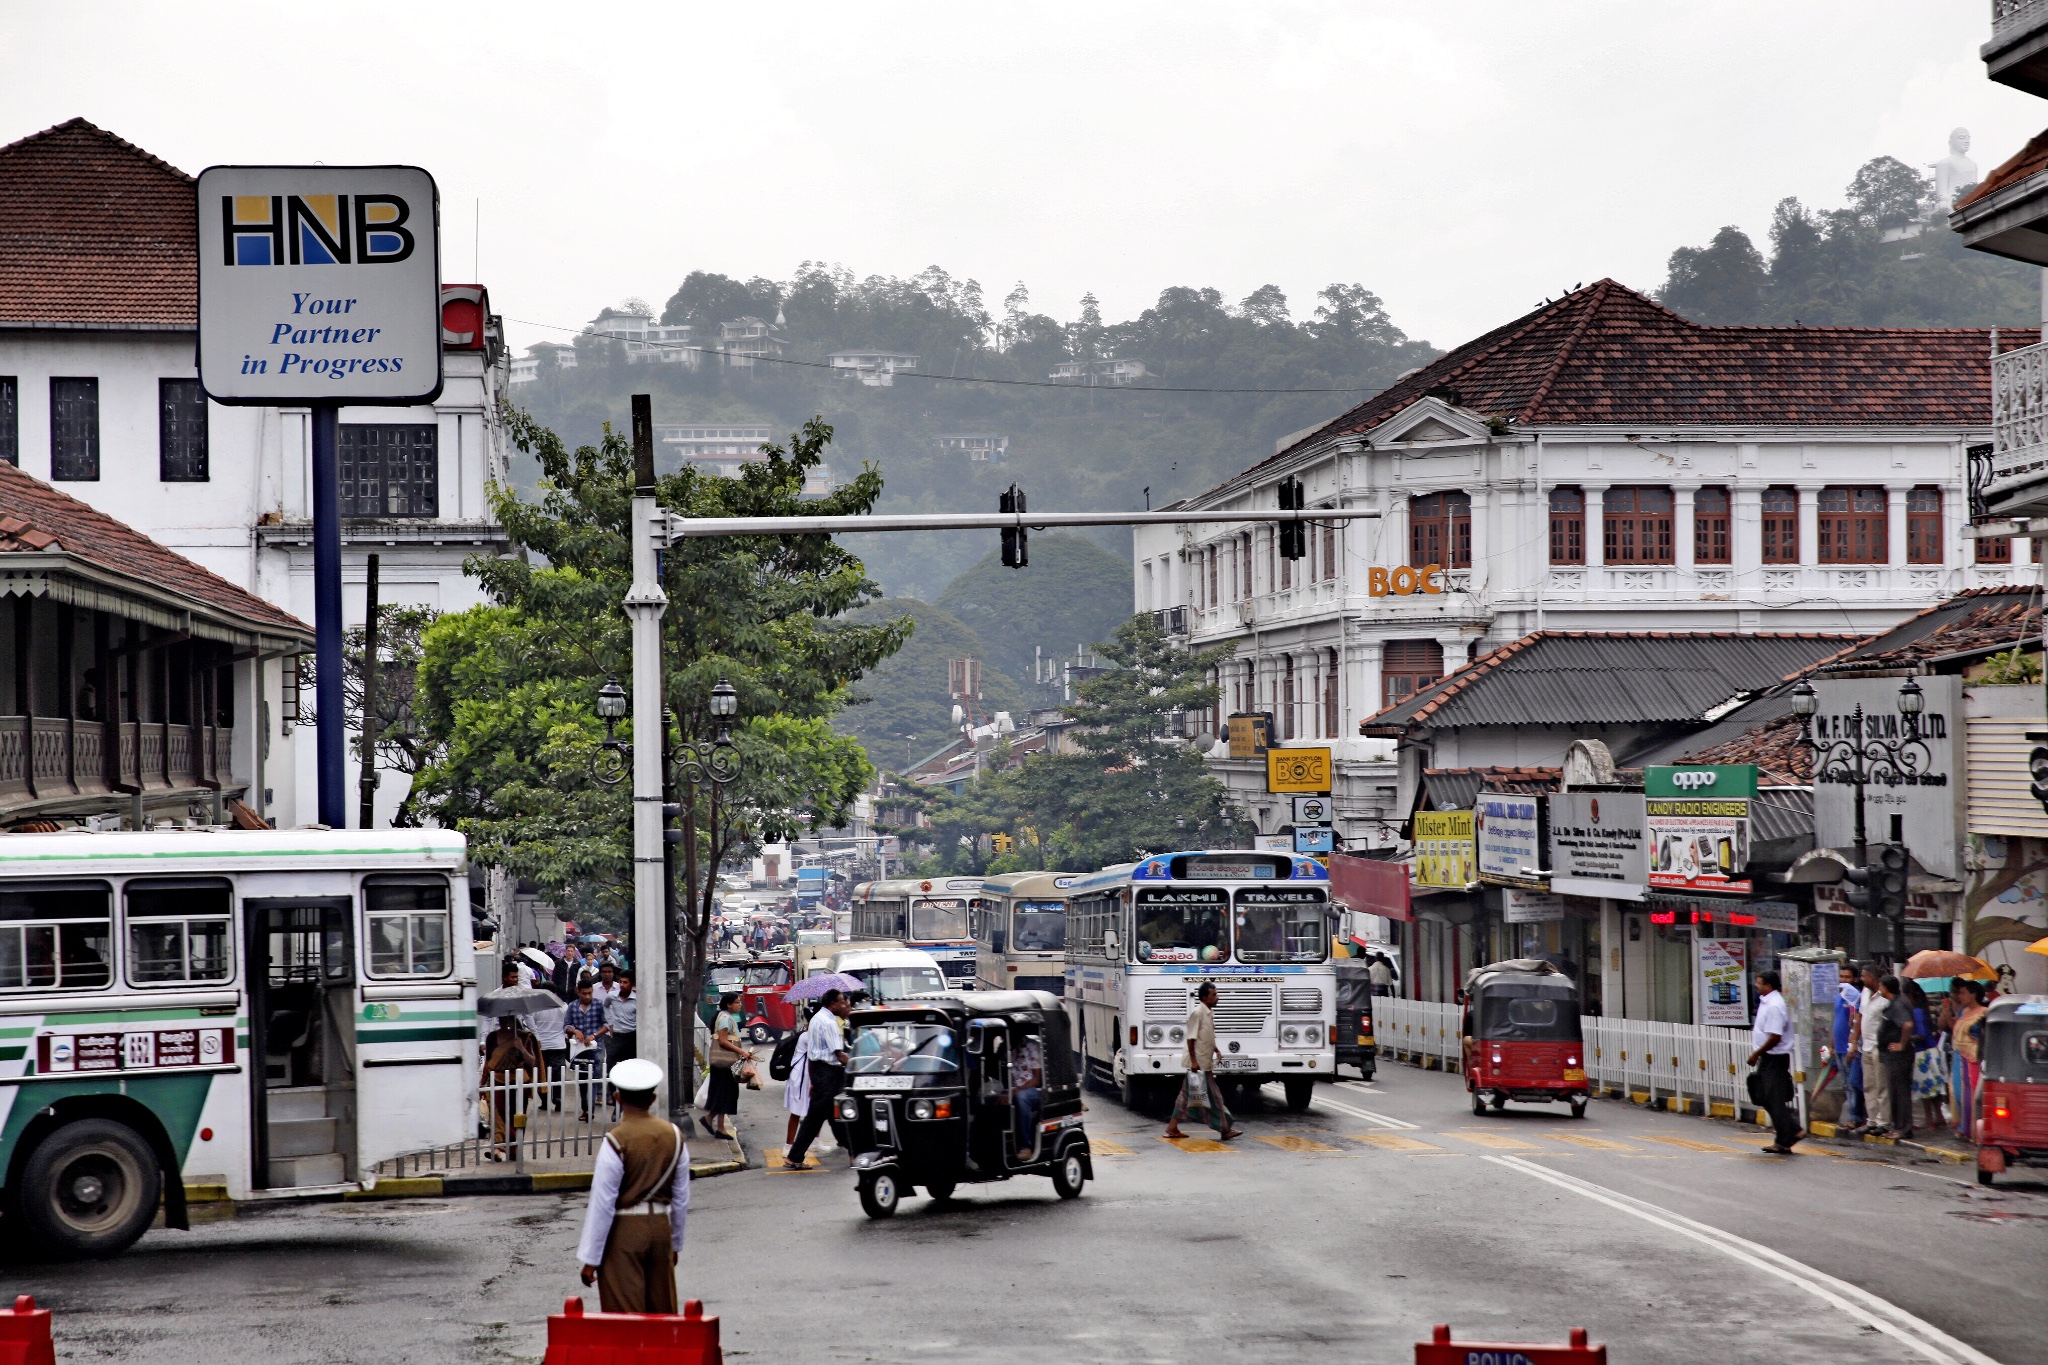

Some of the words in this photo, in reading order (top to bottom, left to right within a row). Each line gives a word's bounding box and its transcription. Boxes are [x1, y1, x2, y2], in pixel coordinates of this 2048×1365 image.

[222, 194, 415, 266] HNB
[291, 292, 357, 315] Your
[269, 323, 381, 344] Partner
[240, 354, 268, 375] in
[278, 353, 404, 380] Progress
[1368, 563, 1441, 597] BOC
[1865, 714, 1898, 739] SILVA
[1275, 761, 1323, 782] BOC
[1647, 802, 1675, 816] KANDY
[1675, 802, 1700, 816] RADIO
[1701, 802, 1747, 816] ENGINEERS
[1416, 817, 1447, 836] Mister
[1448, 815, 1472, 836] Mint
[1255, 867, 1271, 877] 698
[921, 901, 958, 909] DINESH
[1244, 893, 1315, 902] TRAVELS
[158, 1055, 196, 1065] KANDY
